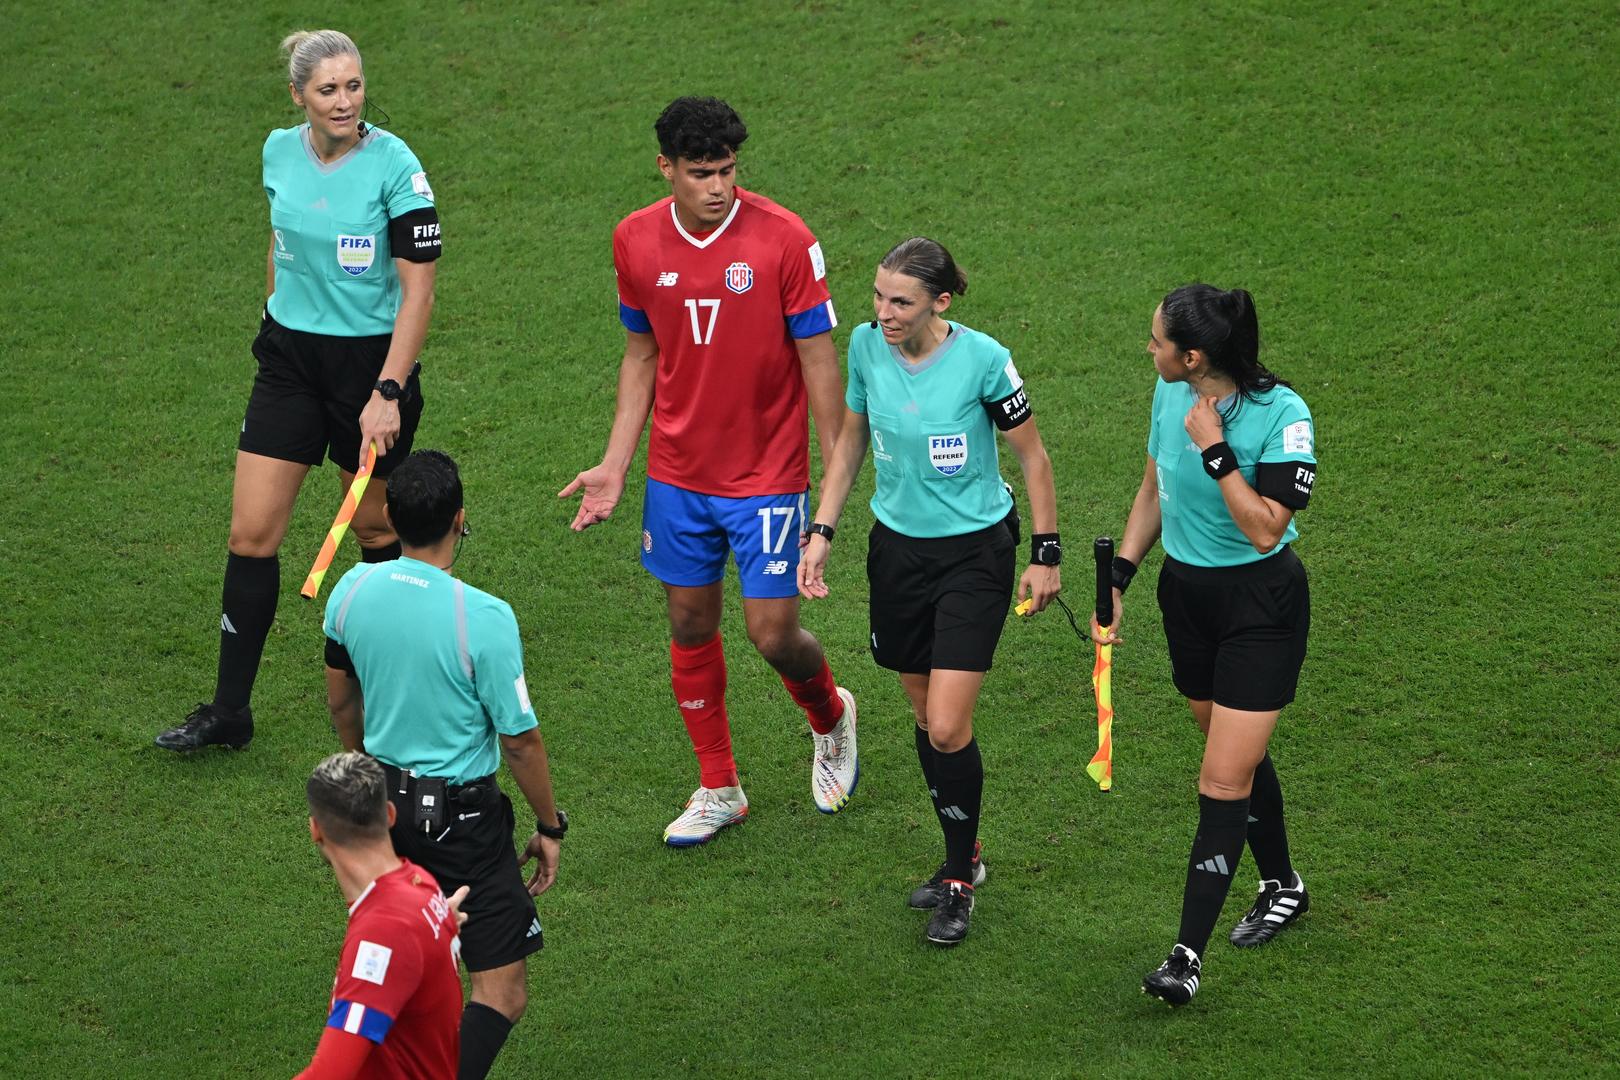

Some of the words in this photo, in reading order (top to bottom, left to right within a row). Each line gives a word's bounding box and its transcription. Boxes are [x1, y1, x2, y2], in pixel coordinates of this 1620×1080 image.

[413, 222, 441, 239] FIFA
[341, 238, 371, 248] FIFA
[414, 240, 432, 248] TEAM
[432, 239, 442, 247] ON
[732, 269, 747, 288] CR
[684, 298, 721, 345] 17
[1009, 406, 1026, 420] TEAM
[932, 437, 963, 448] FIFA
[933, 452, 964, 460] REFEREE
[1295, 467, 1315, 485] FIF
[1294, 482, 1309, 494] TEAM
[757, 506, 795, 554] 17
[390, 572, 430, 588] MARTINEZ
